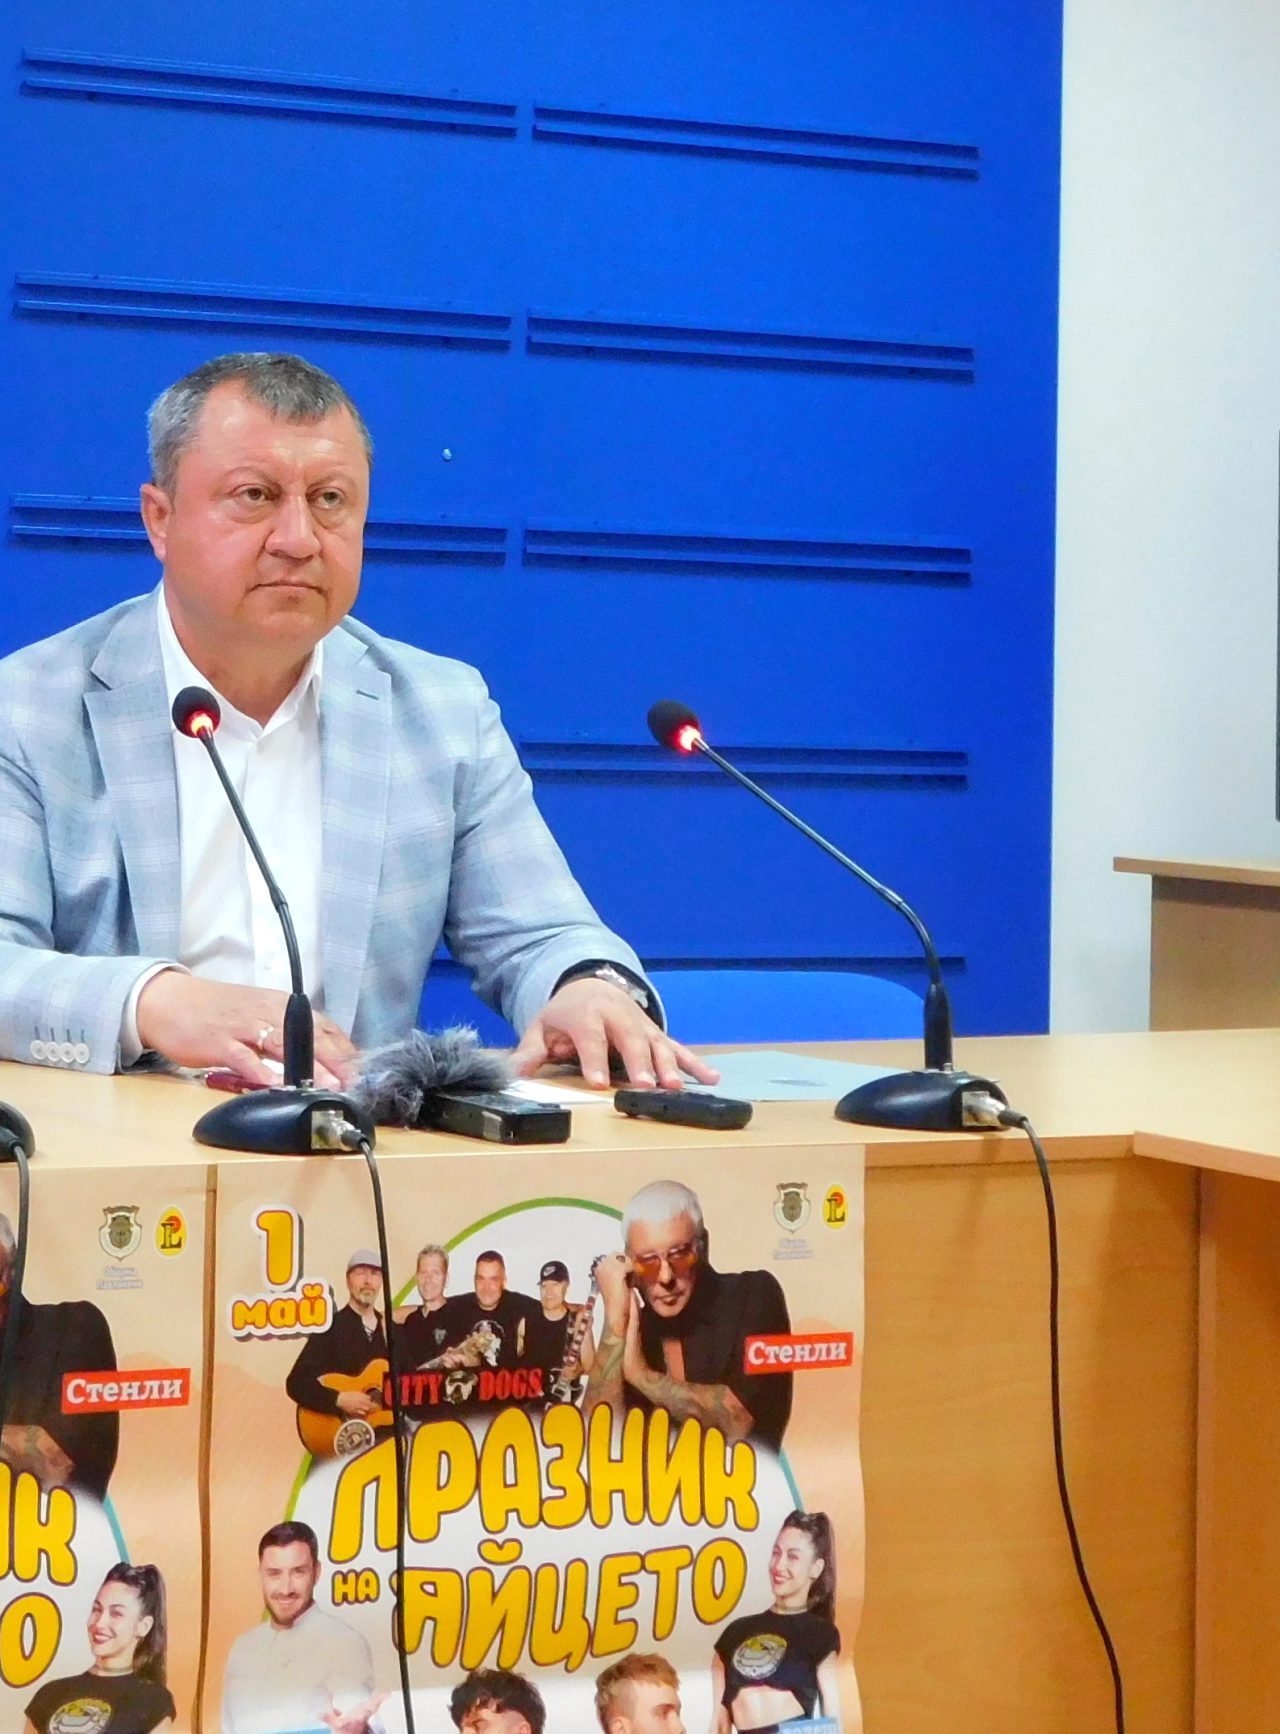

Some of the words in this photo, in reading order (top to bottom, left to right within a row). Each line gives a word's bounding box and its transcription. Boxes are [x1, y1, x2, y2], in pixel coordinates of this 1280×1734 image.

[256, 1209, 294, 1285] 1
[231, 1282, 328, 1331] май
[748, 1339, 847, 1366] Стенли
[66, 1377, 183, 1405] Стенли
[479, 1368, 543, 1400] DOGS
[327, 1402, 759, 1564] ПРАЗНИК
[391, 1537, 748, 1673] ЯЙЦЕТО
